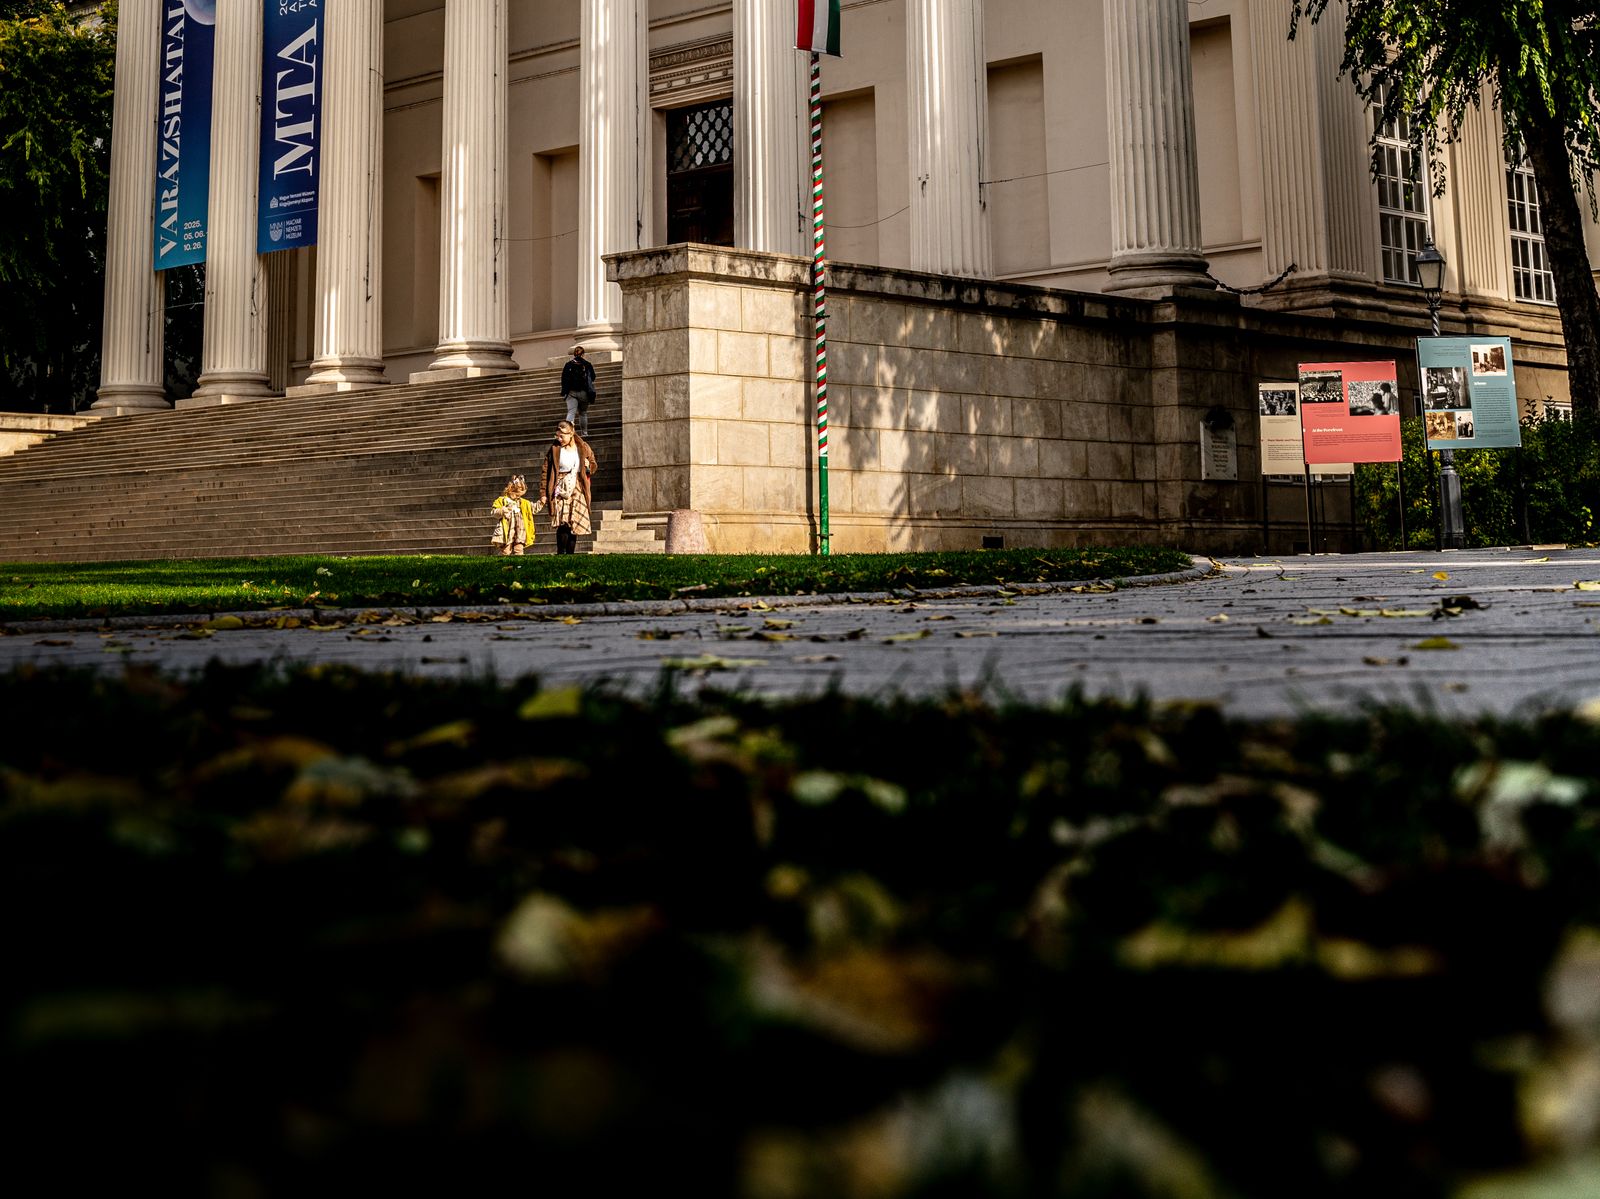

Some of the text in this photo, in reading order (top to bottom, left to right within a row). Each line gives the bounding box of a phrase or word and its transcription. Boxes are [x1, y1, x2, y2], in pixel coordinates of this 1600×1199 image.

[289, 2, 297, 13] A
[273, 18, 318, 181] MTA
[183, 220, 202, 230] 2025.
[183, 232, 194, 241] 05.
[183, 243, 192, 251] 10.
